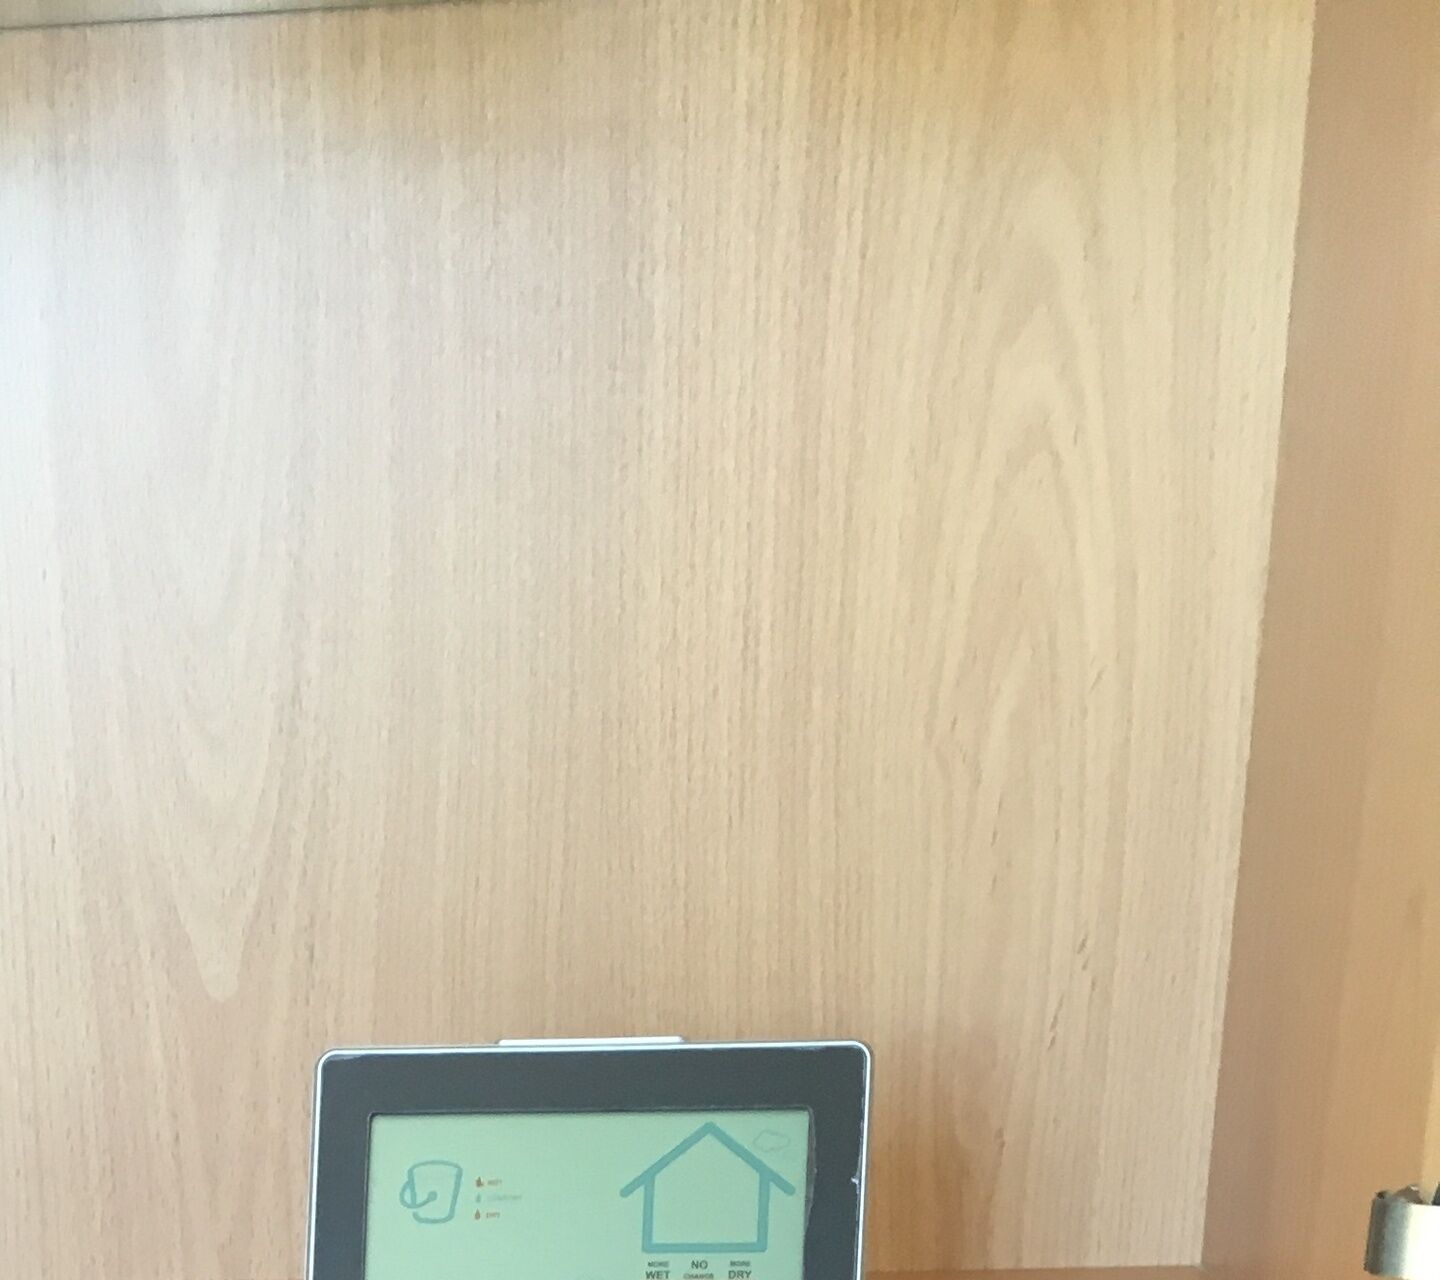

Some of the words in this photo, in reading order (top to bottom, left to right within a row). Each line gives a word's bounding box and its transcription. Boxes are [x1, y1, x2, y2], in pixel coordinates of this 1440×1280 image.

[691, 1260, 709, 1270] NO
[645, 1270, 671, 1280] WET
[728, 1270, 752, 1280] DRY
